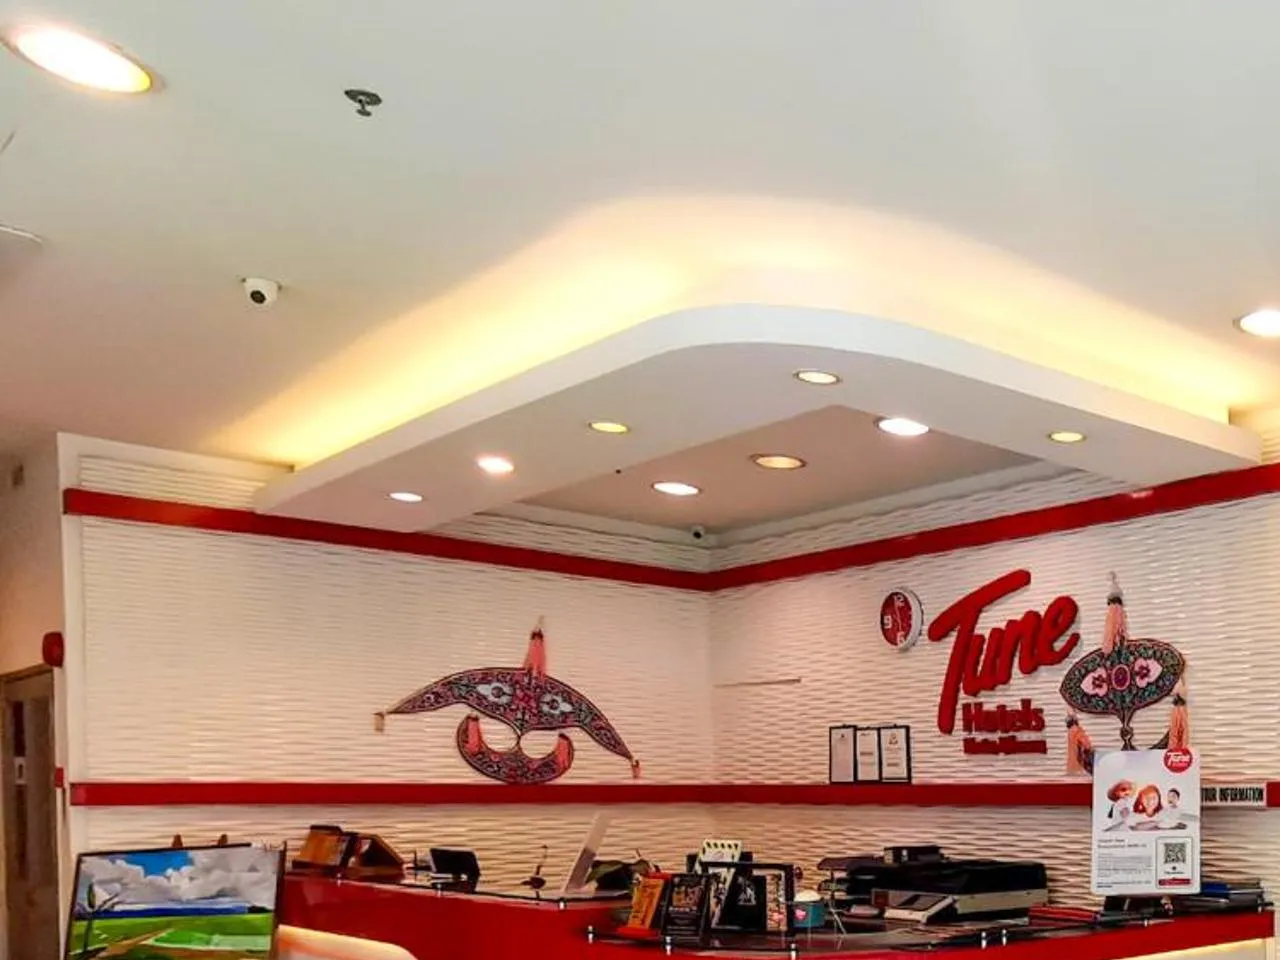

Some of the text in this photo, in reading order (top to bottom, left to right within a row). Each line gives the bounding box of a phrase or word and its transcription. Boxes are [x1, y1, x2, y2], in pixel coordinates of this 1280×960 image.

[928, 570, 1081, 735] Tune
[962, 698, 1045, 734] Hotels
[1219, 787, 1264, 802] INFORMATION
